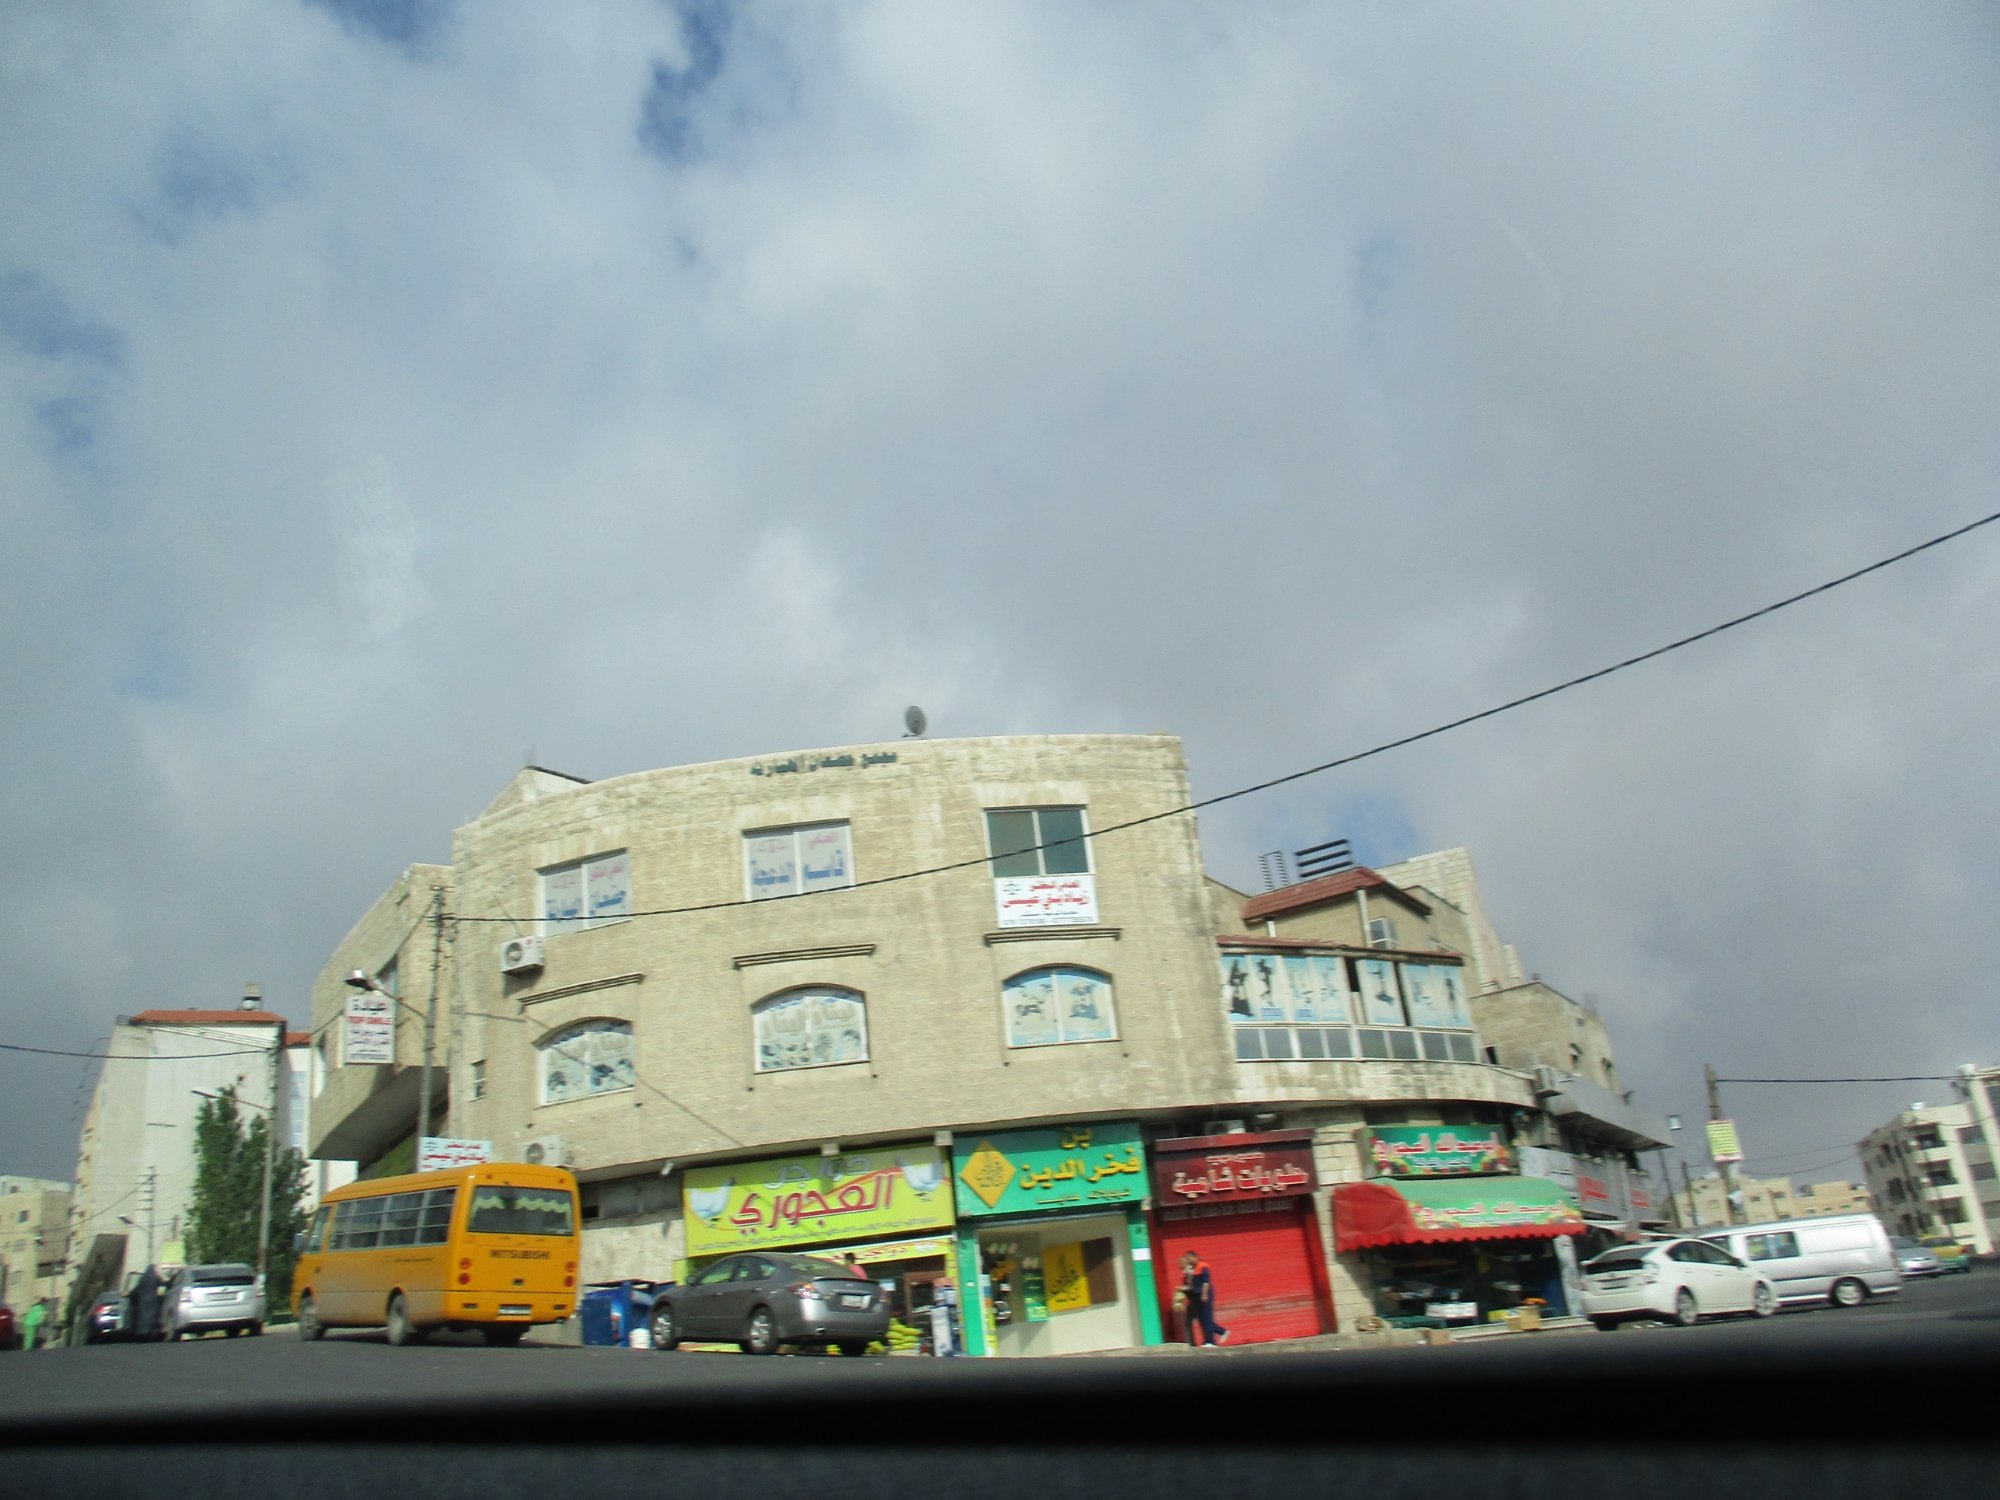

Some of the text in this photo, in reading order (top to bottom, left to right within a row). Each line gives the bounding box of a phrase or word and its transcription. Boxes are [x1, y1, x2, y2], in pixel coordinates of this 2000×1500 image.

[1060, 1127, 1092, 1149] بن
[1019, 1159, 1086, 1190] الدين
[1087, 1147, 1142, 1183] فخر
[1172, 1163, 1309, 1199] حلويات شامية
[490, 1249, 552, 1260] MITSUBISHI
